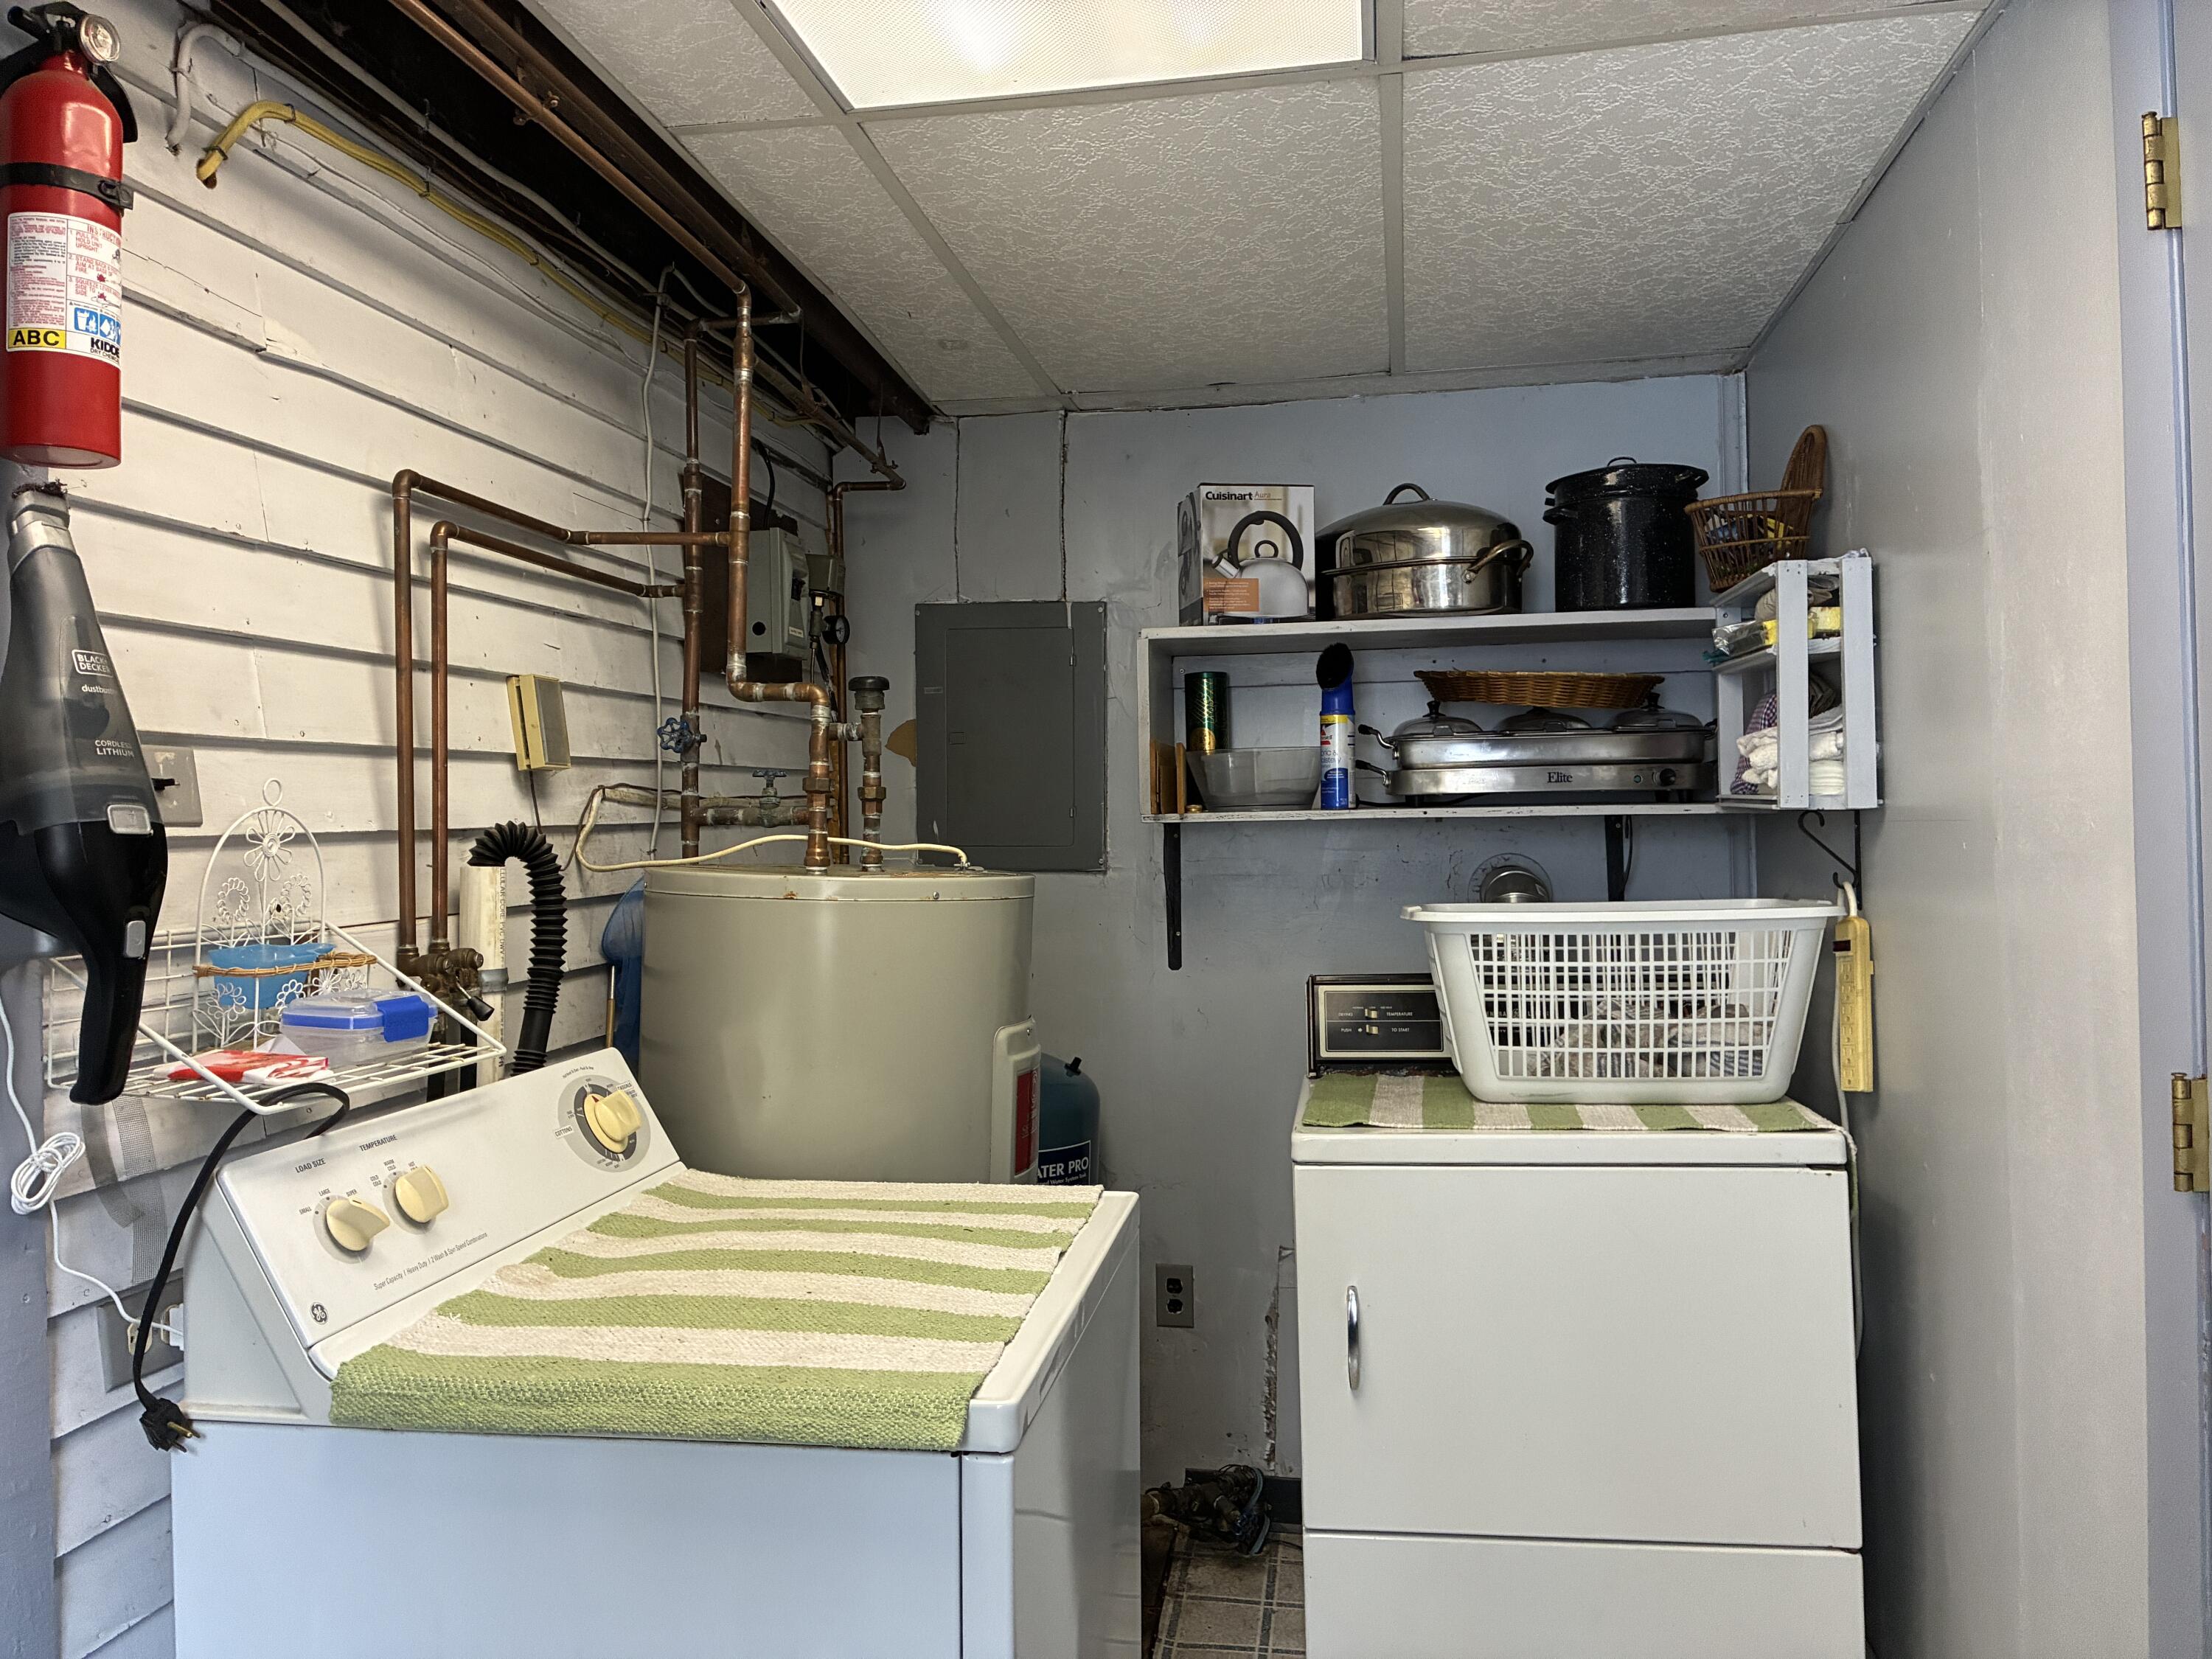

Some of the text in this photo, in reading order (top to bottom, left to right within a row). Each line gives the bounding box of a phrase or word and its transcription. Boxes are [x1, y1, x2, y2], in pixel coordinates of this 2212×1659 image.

[1206, 491, 1271, 501] Cuisinart Aura
[79, 662, 111, 672] DECKER
[97, 748, 134, 757] LITHIUM
[1547, 772, 1573, 783] Elite
[554, 1126, 572, 1136] COTTONS
[359, 1134, 397, 1152] TEMPERATURE
[295, 1158, 326, 1173] LOAD SIZE
[1068, 1156, 1089, 1174] PRO
[319, 1188, 330, 1196] LARGE
[373, 1279, 386, 1290] Super
[386, 1273, 403, 1285] Capacity
[406, 1265, 419, 1275] Heavy
[417, 1260, 428, 1270] Duty
[434, 1252, 445, 1262] Wash
[448, 1247, 456, 1256] Spin
[455, 1242, 466, 1251] Speed
